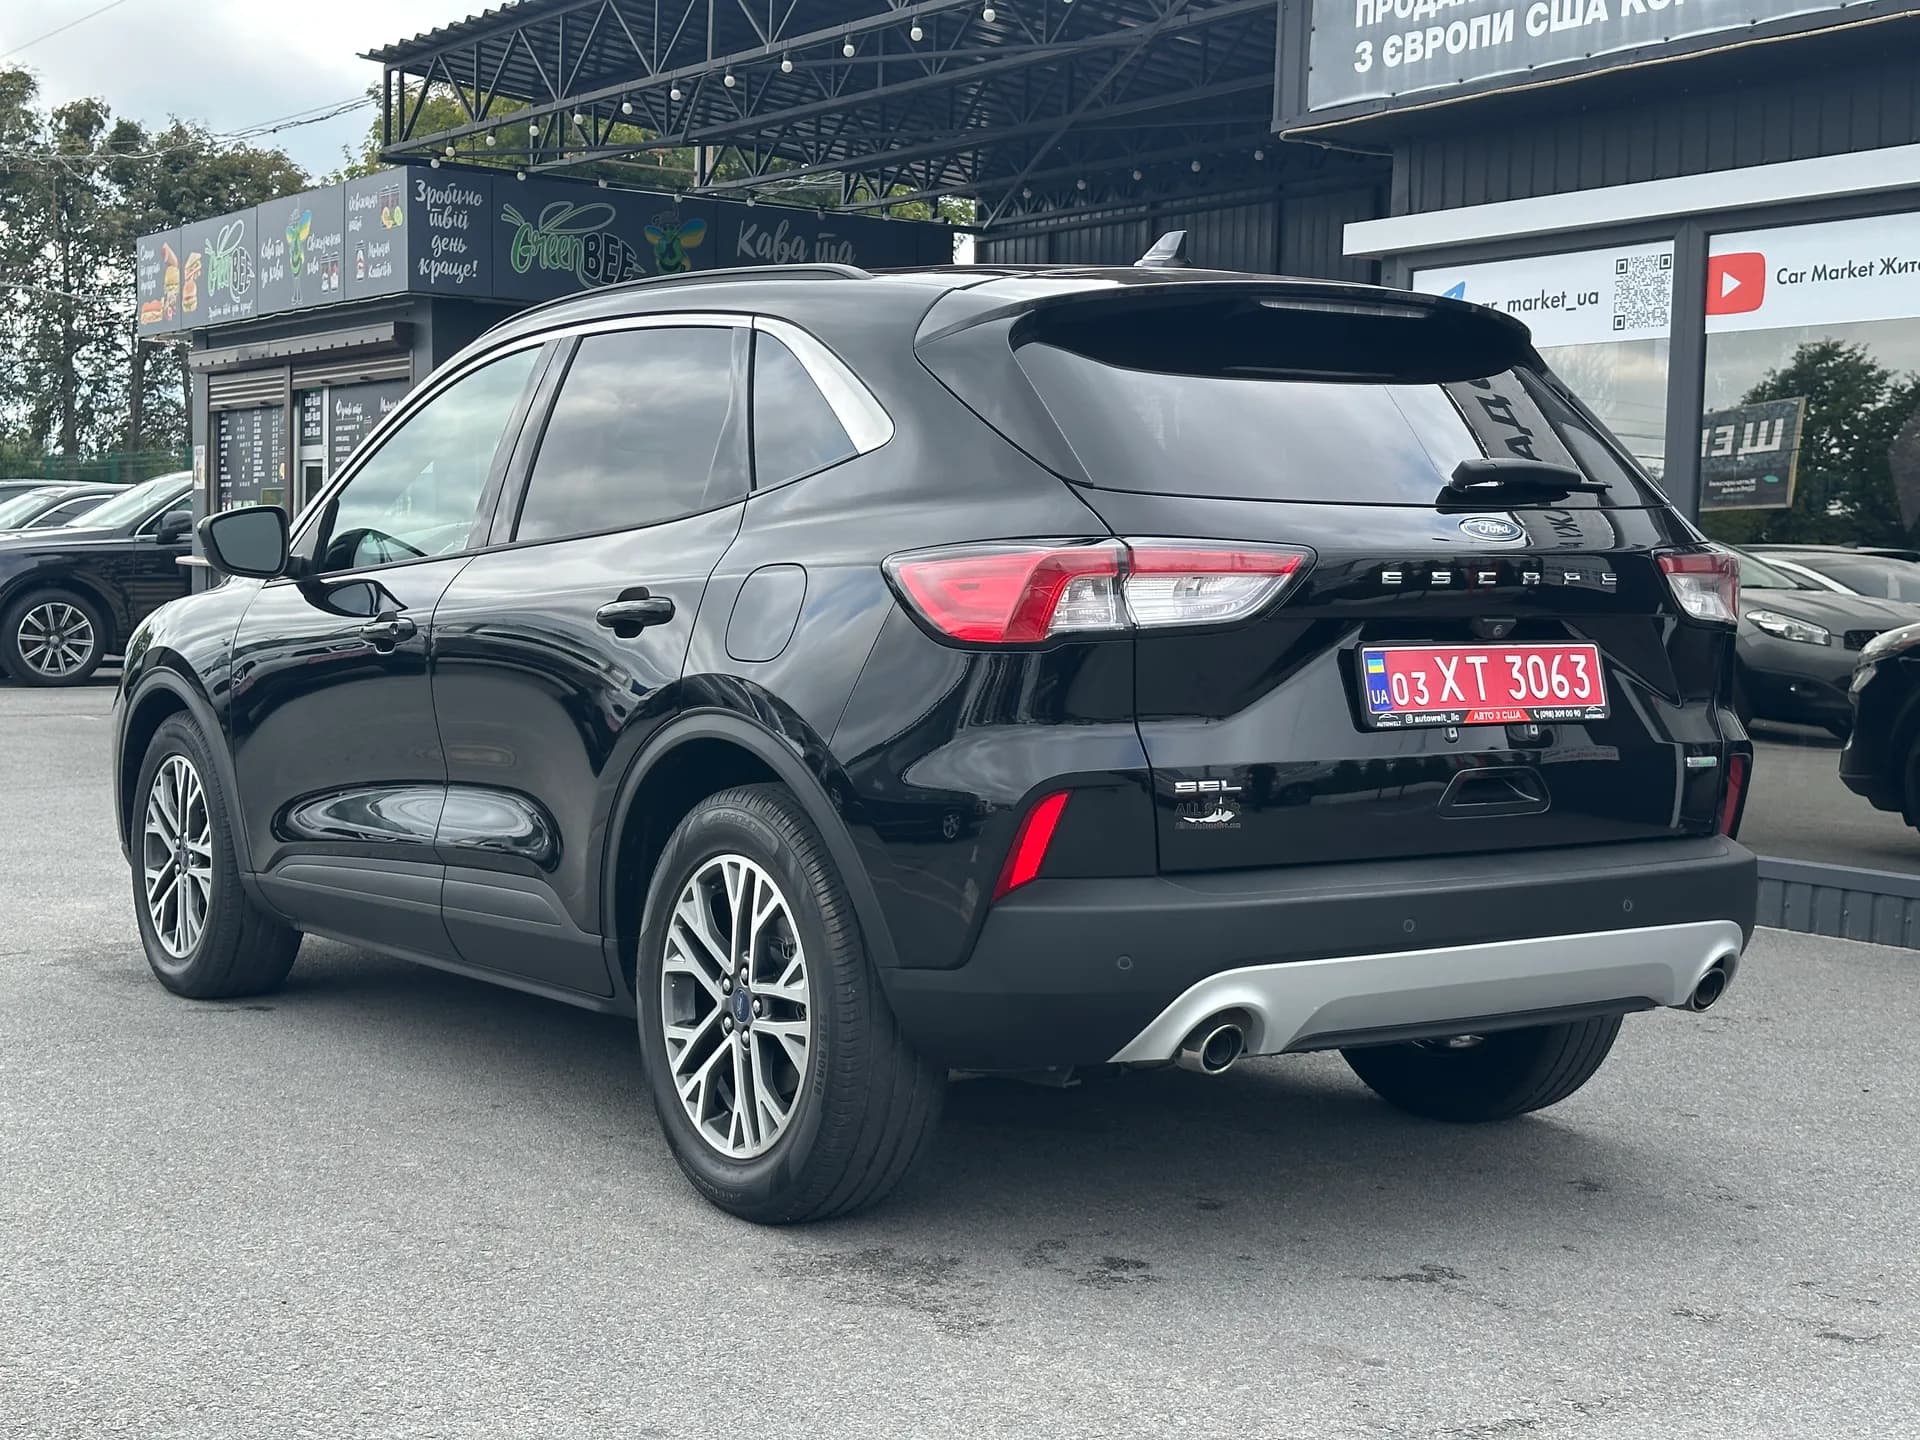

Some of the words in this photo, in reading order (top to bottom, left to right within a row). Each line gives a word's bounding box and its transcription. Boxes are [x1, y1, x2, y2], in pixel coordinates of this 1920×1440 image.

[1355, 0, 1478, 28] ПРОД
[1354, 41, 1373, 73] З
[1382, 9, 1515, 68] ЄВРОПИ
[1526, 0, 1608, 37] США
[415, 179, 483, 210] Зробимо
[429, 206, 470, 230] твій
[431, 234, 468, 257] день
[737, 219, 808, 264] Кава
[815, 232, 857, 265] та
[418, 257, 478, 284] краще!
[1776, 267, 1807, 285] Car
[1811, 259, 1875, 282] Market
[1878, 256, 1920, 276] Жит
[1381, 571, 1617, 585] ESCAPE
[1372, 689, 1389, 705] UA
[1391, 671, 1430, 706] 03
[1433, 655, 1488, 702] XT
[1504, 654, 1591, 700] 3063
[1473, 710, 1494, 720] АВТО
[1174, 780, 1242, 792] SEL
